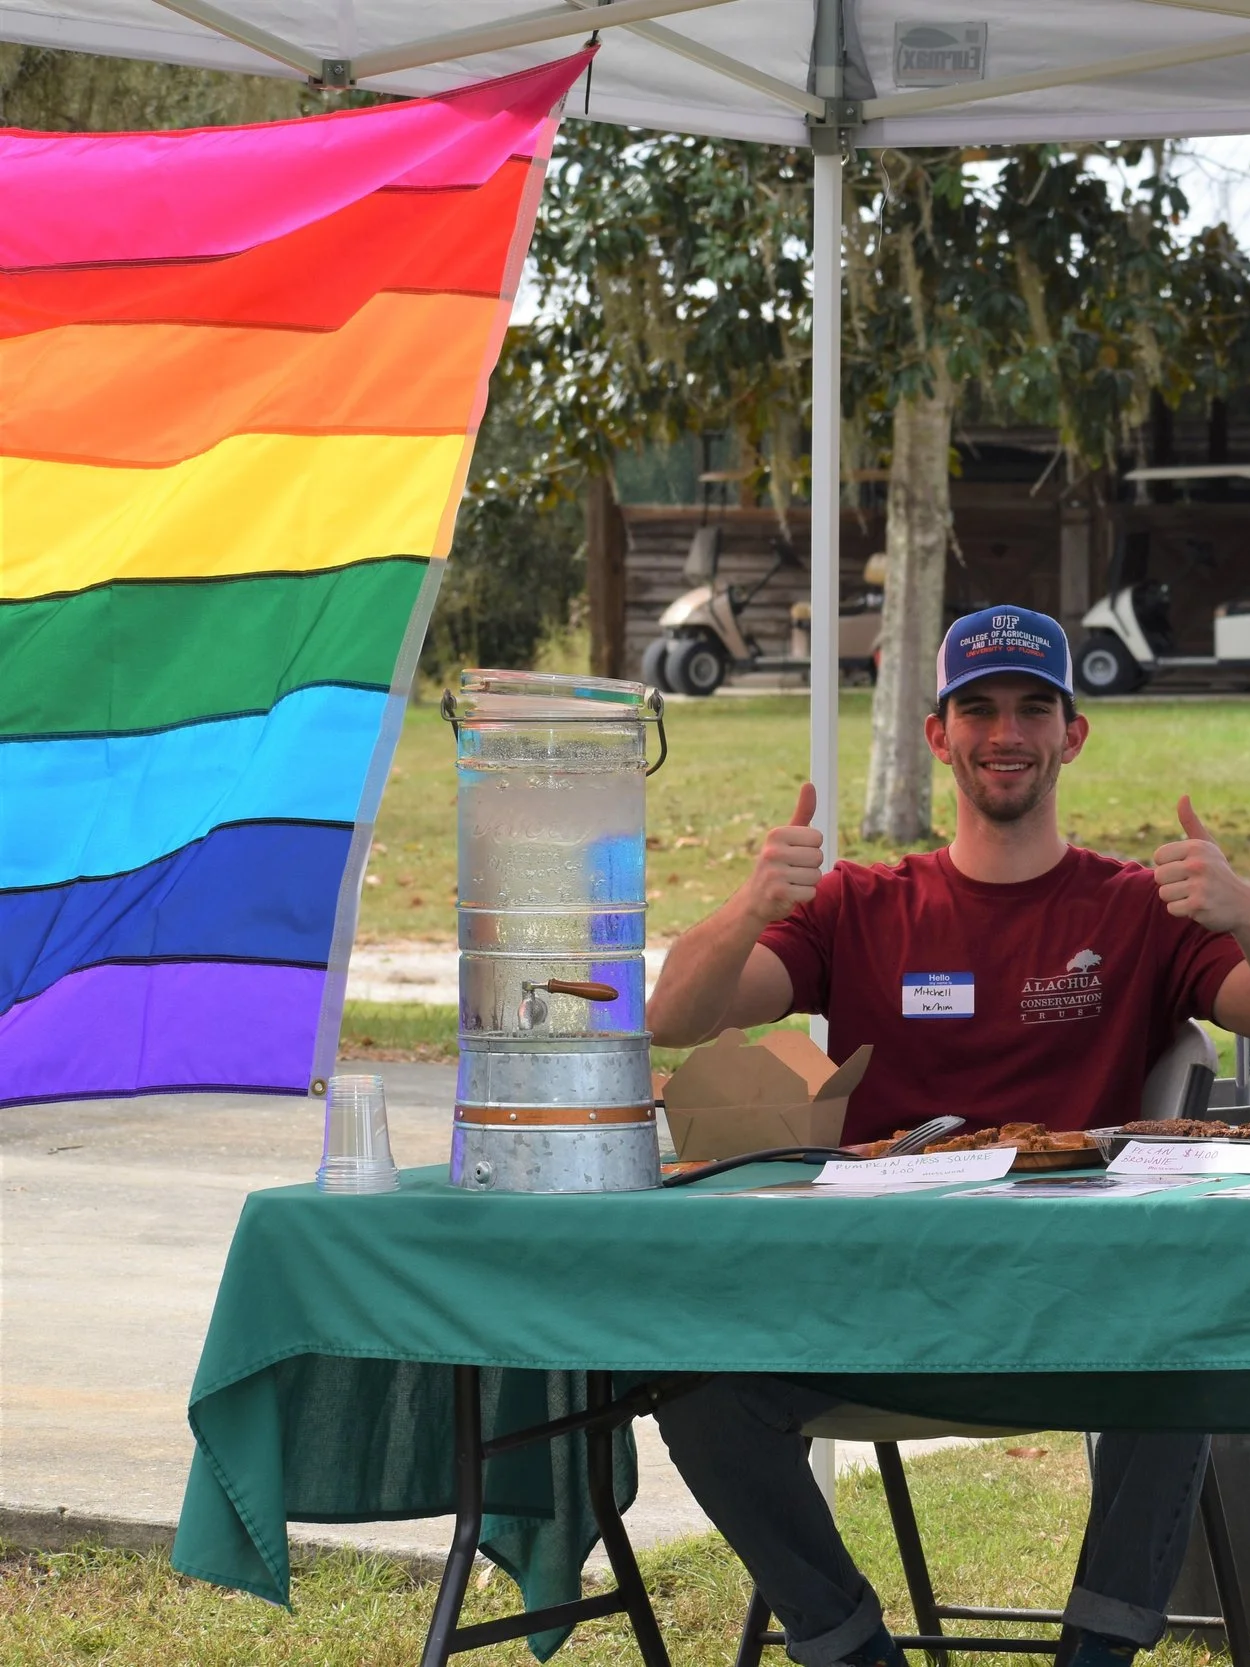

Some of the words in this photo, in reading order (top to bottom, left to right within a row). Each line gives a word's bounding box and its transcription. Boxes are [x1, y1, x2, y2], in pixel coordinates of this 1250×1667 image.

[992, 615, 1020, 630] UF
[960, 632, 989, 647] COLLEGE
[991, 630, 1001, 638] OF
[1001, 630, 1052, 648] AGRICULTURAL
[972, 641, 986, 650] AND
[988, 639, 1004, 647] LIFE
[1006, 638, 1040, 651] SCIENCES
[966, 646, 1002, 658] UNIVERSITY
[1018, 646, 1045, 658] FLORIDA
[928, 974, 950, 982] Hello
[1021, 976, 1102, 993] ALACHUA
[914, 986, 951, 997] Mitchell
[922, 1002, 953, 1011] he/him
[1020, 993, 1102, 1009] CONSERVATION
[1020, 1006, 1102, 1021] TRUST
[1131, 1146, 1175, 1155] PECAN
[835, 1159, 900, 1170] PUMPKIN
[947, 1152, 994, 1164] SQUARE
[1121, 1155, 1178, 1165] BROWNIE
